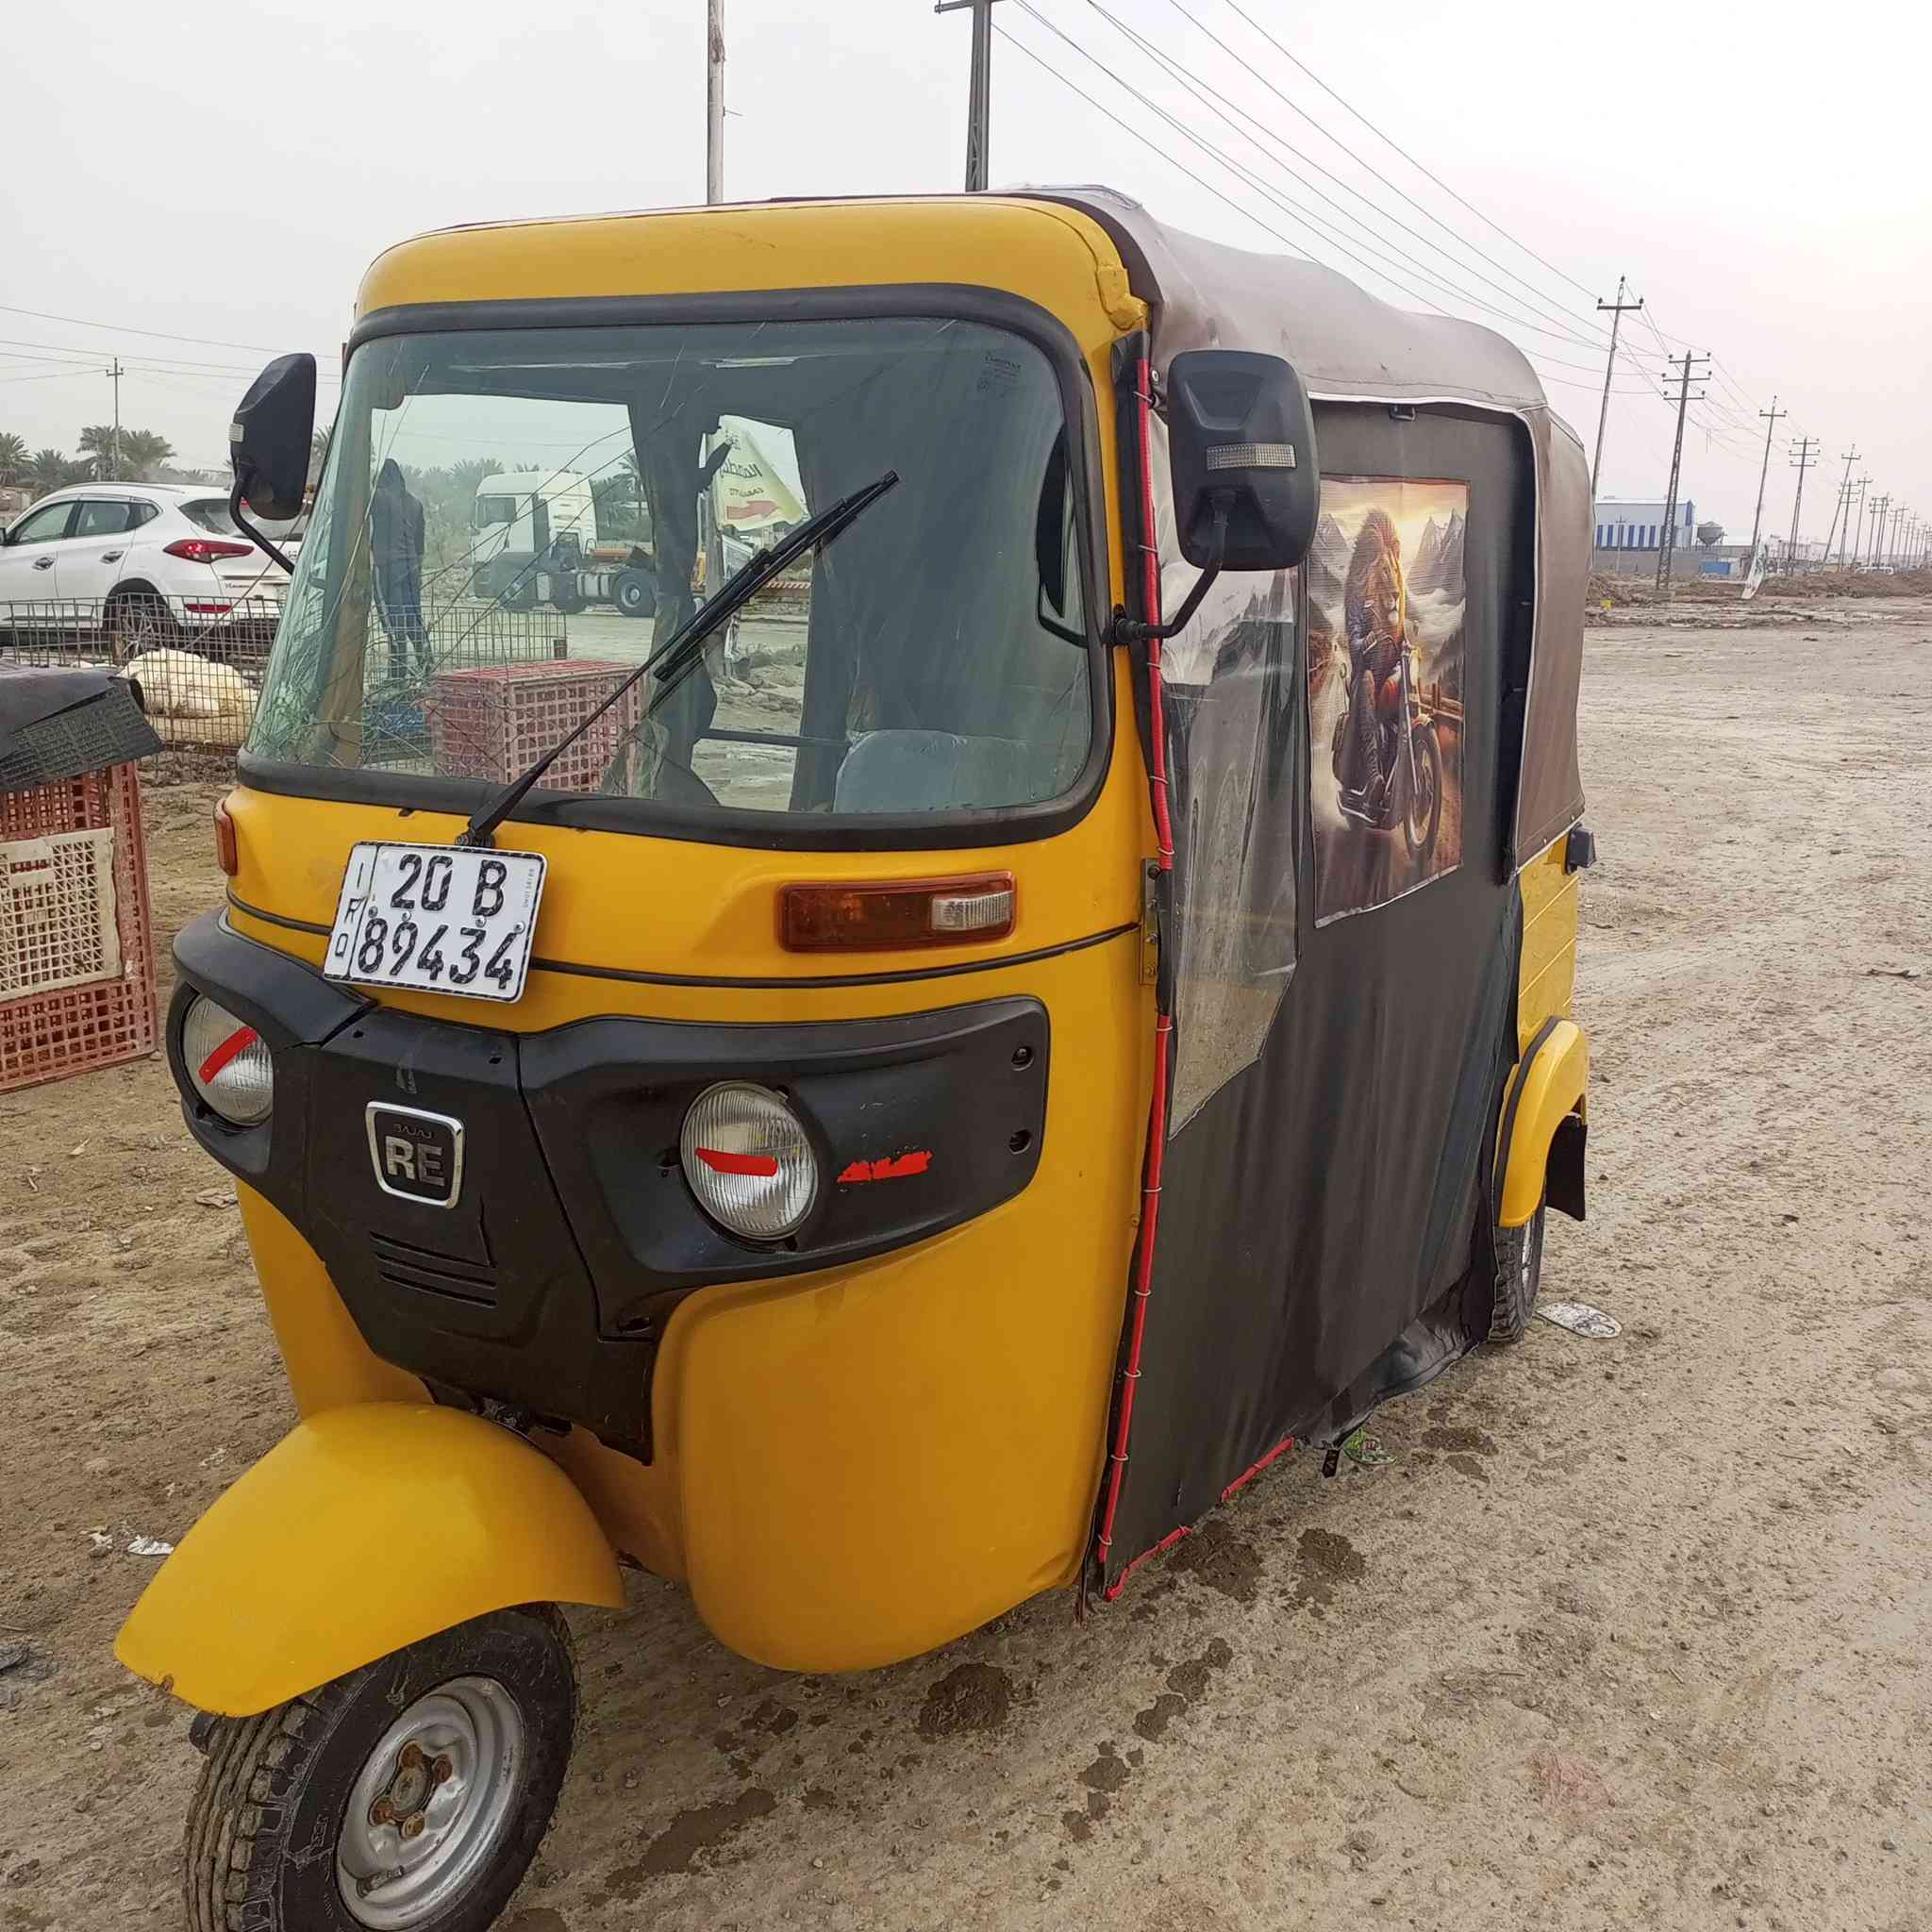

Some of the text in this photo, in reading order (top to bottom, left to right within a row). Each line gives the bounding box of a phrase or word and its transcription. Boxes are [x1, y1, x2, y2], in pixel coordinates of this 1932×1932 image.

[391, 854, 453, 911] 20
[473, 859, 508, 917] B
[358, 918, 518, 990] 89434
[385, 1135, 446, 1187] RE
